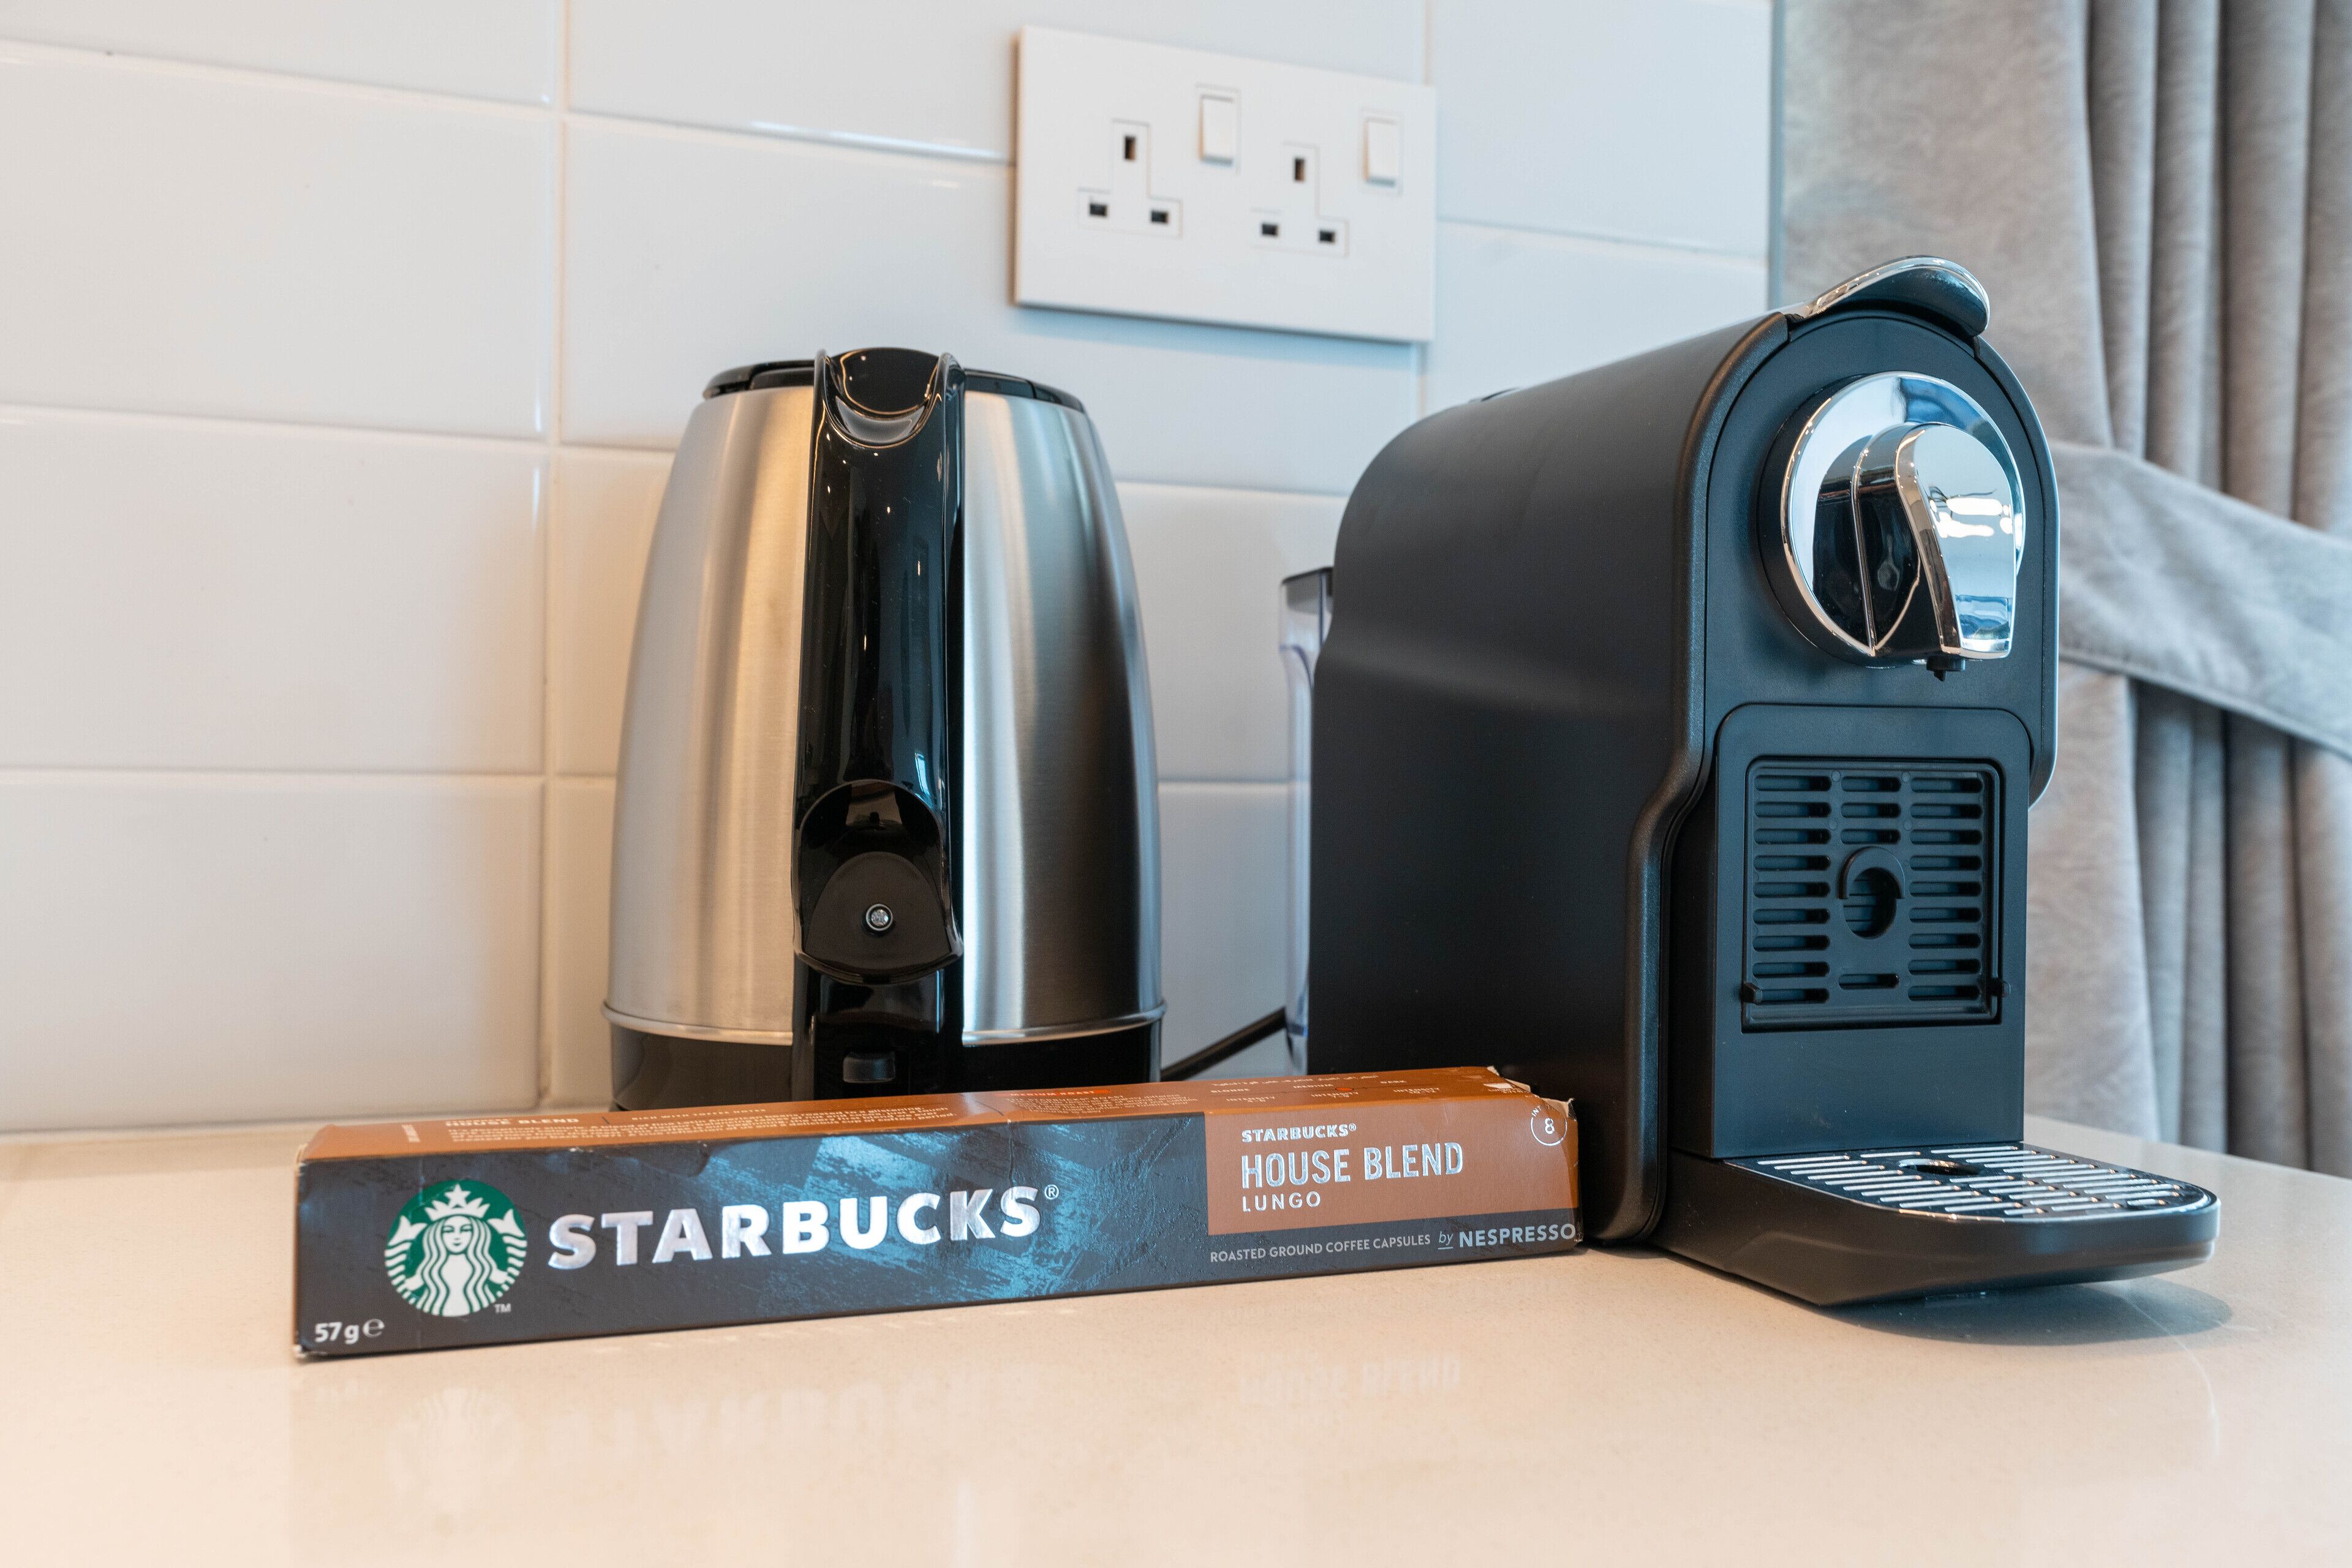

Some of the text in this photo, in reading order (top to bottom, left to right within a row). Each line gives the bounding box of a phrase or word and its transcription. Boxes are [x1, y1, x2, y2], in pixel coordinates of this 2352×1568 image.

[1544, 1117, 1555, 1135] 8
[1241, 1142, 1464, 1189] HOUSE BLEND
[1242, 1191, 1322, 1213] LUNGO
[1210, 1223, 1577, 1263] ROASTED GROUND COFFEE CAPSULES by NESPRESSO
